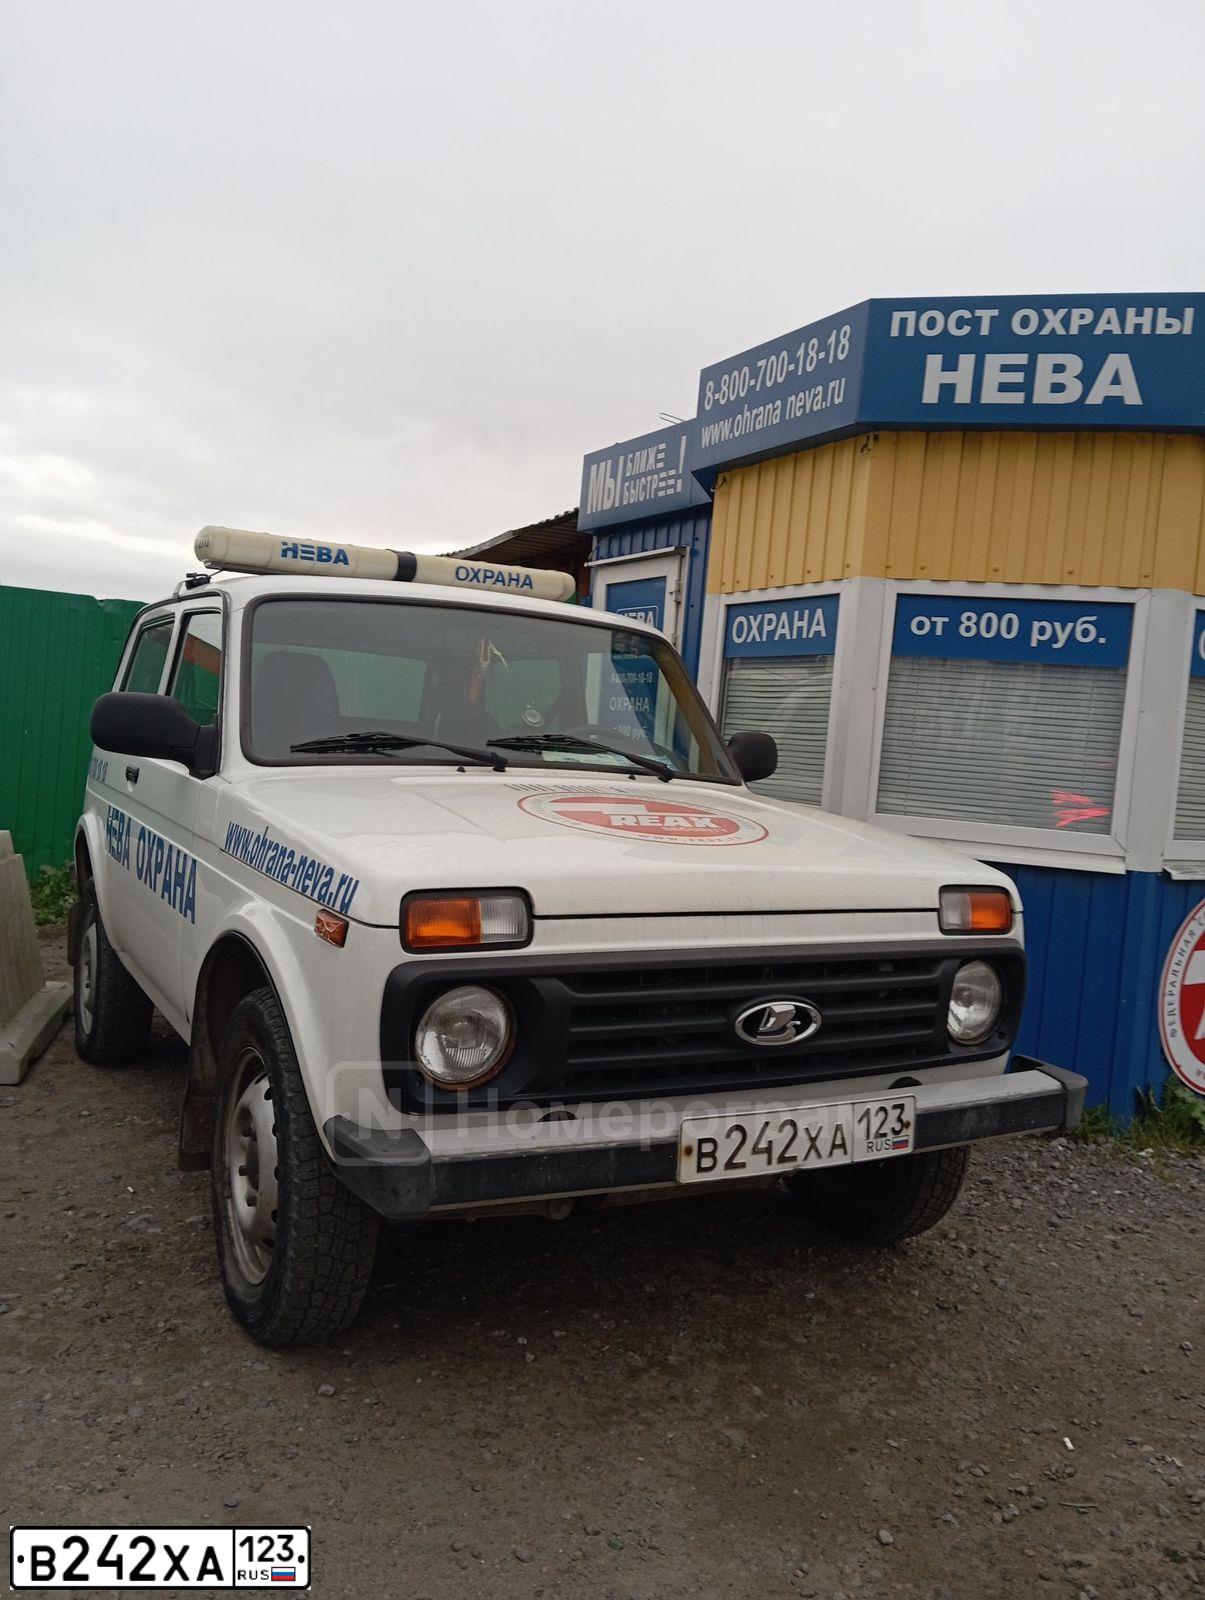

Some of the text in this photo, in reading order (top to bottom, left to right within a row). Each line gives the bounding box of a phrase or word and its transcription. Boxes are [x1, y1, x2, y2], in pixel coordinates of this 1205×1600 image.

[890, 307, 1196, 337] ПОСТ ОХРАНЫ
[703, 324, 851, 411] 8-800-700-18-18
[921, 353, 1145, 406] НЕВА
[625, 442, 667, 478] БЛИЖЕ
[586, 455, 625, 515] МЫ
[280, 541, 350, 566] НЕВА
[455, 565, 534, 590] ОХРАНА
[732, 608, 827, 643] ОХРАНА
[910, 611, 1107, 649] от 800 руб.
[608, 696, 650, 712] ОХРАНА
[136, 826, 198, 925] ОХРАНА
[224, 821, 360, 914] www.ohrana-neva.ru
[696, 1102, 906, 1173] В242ХА 123
[866, 1138, 891, 1153] RUS
